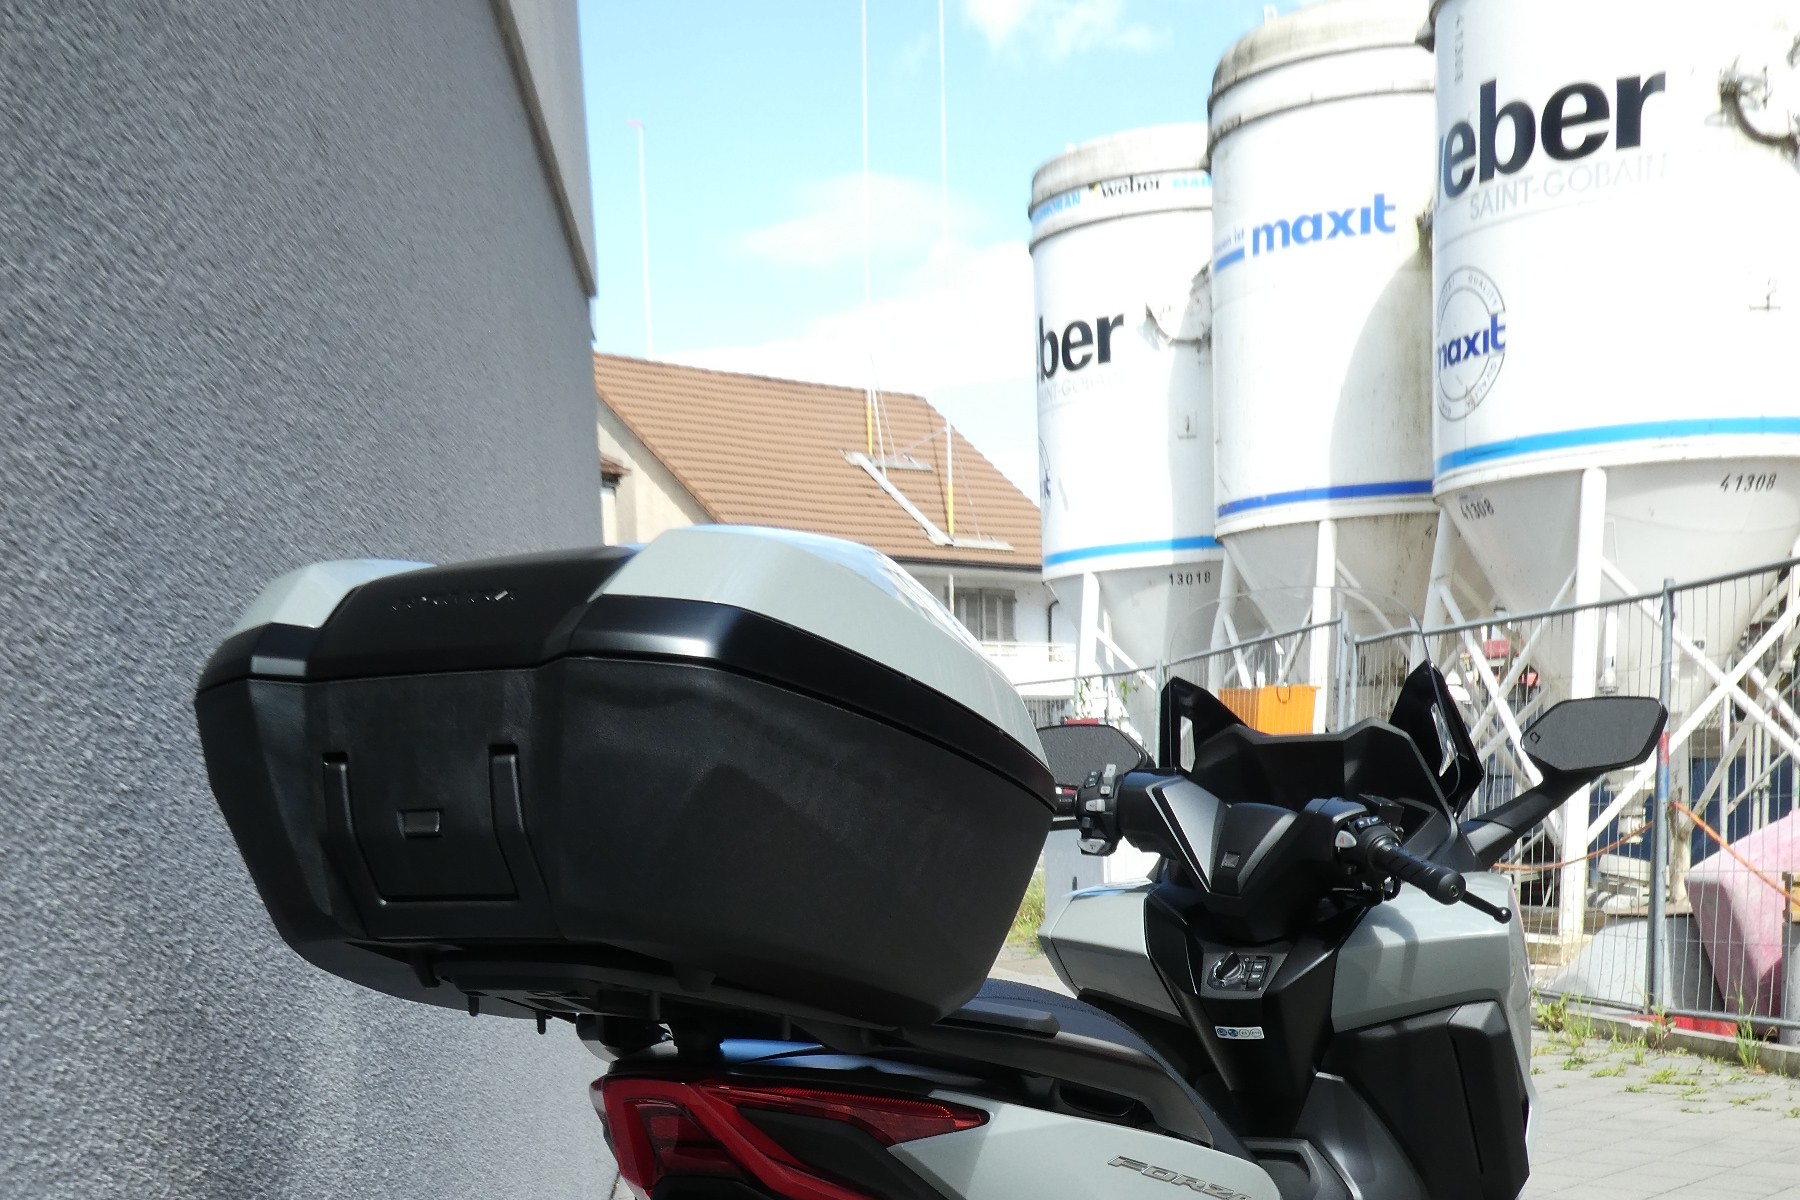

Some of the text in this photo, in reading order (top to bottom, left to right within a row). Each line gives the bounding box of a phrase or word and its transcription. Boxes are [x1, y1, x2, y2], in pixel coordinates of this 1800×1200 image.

[1435, 71, 1666, 208] eber
[1252, 192, 1396, 258] maxit
[1038, 313, 1124, 384] ber
